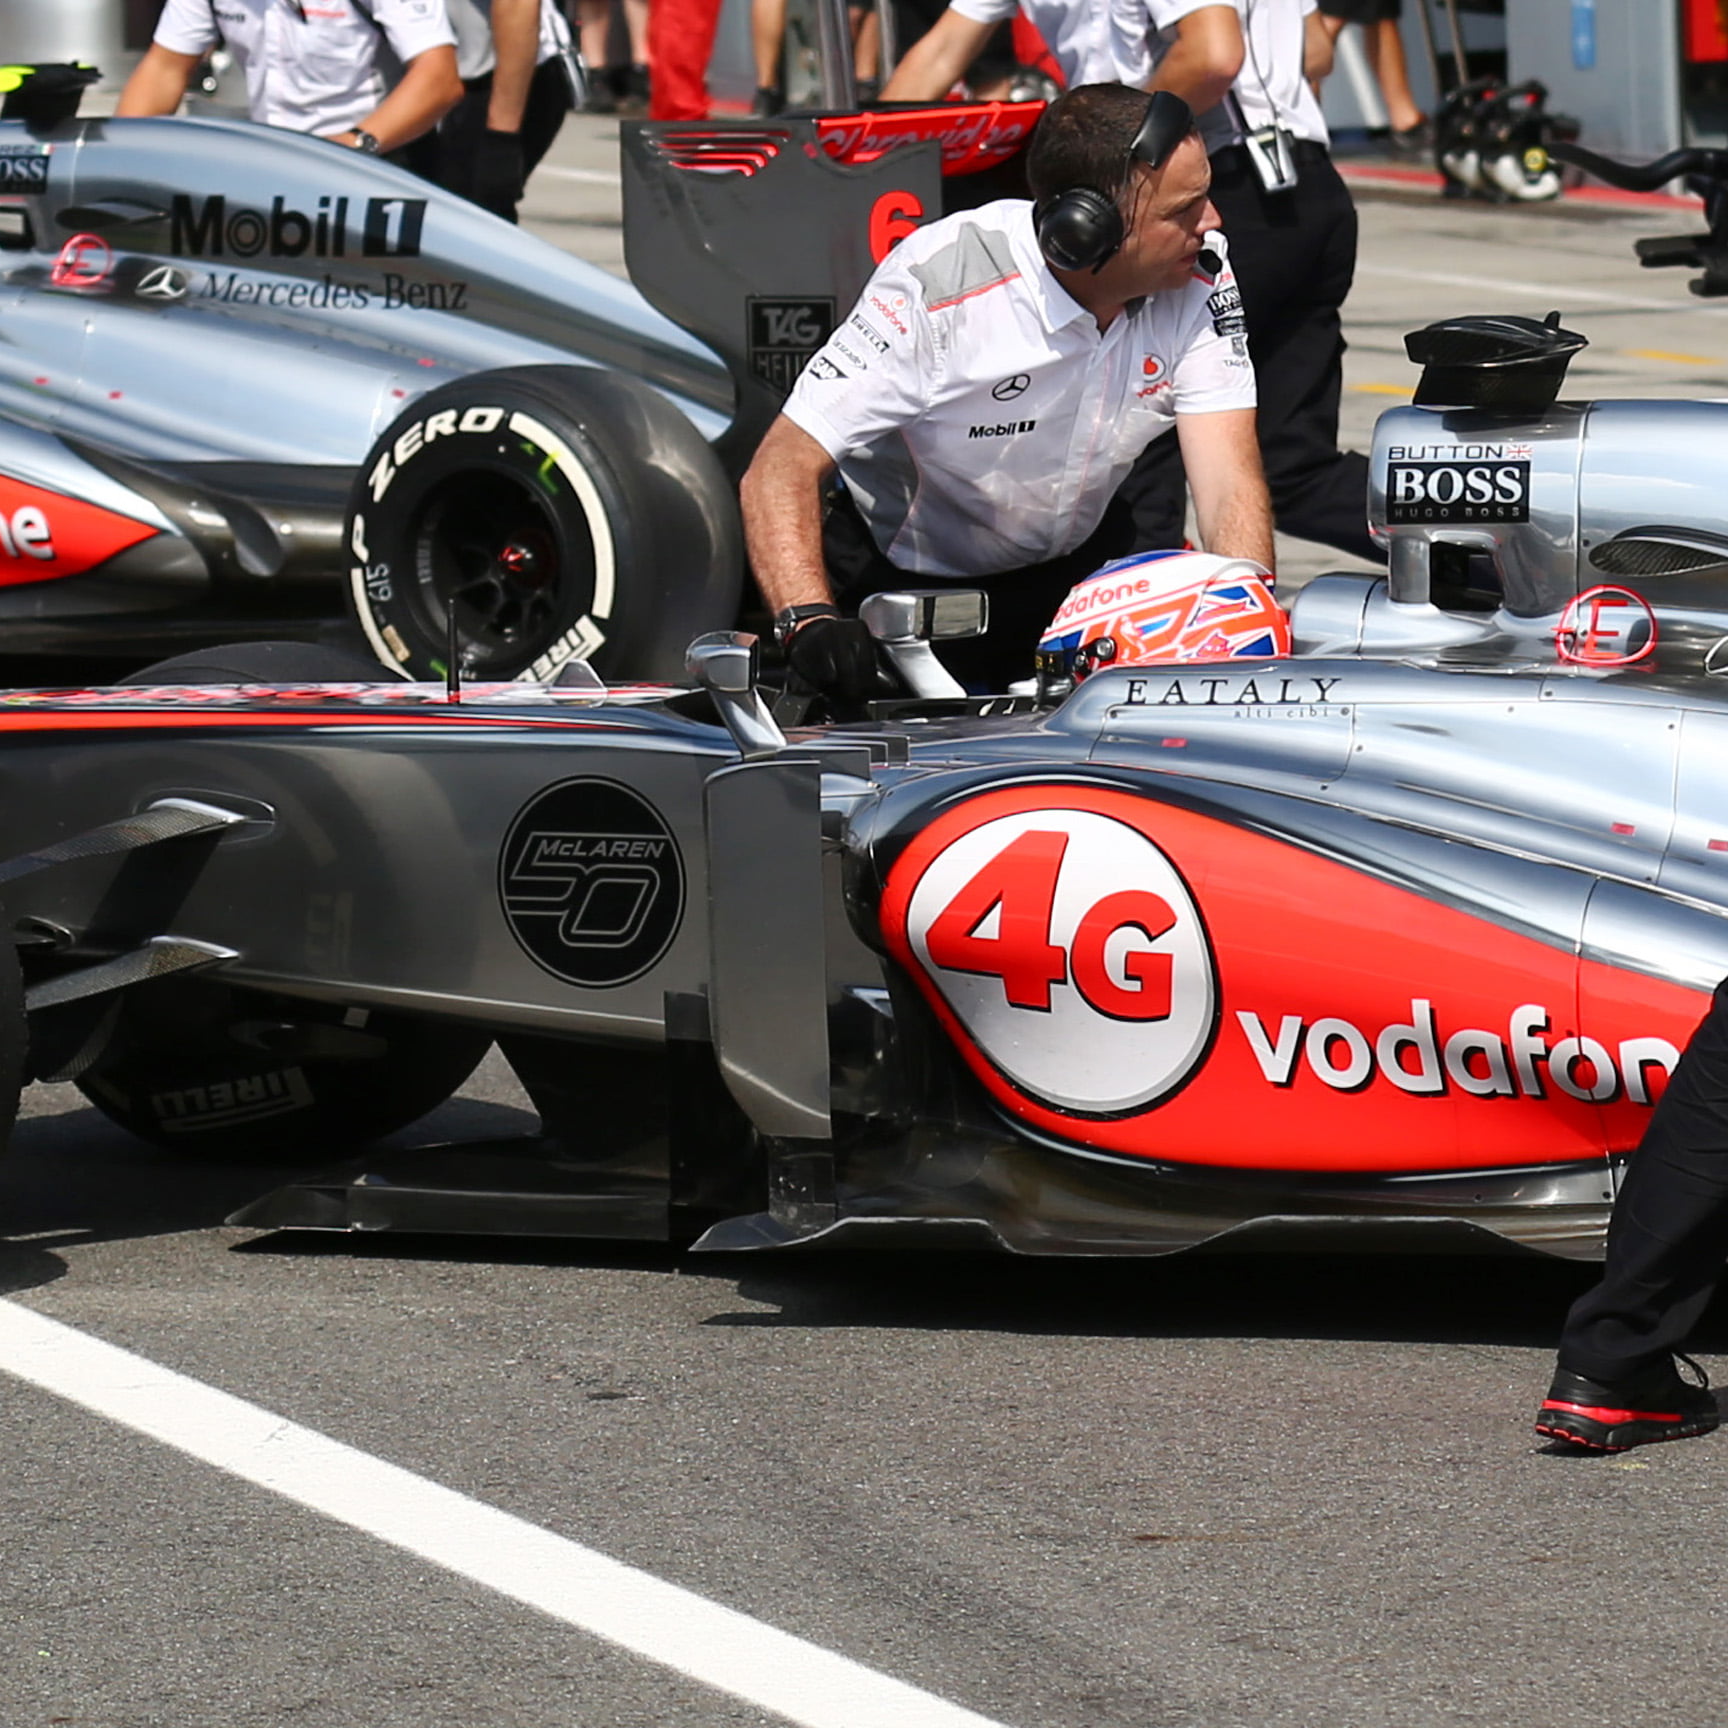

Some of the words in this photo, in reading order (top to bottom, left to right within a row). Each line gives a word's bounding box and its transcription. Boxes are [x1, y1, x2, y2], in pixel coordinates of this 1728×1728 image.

[173, 195, 345, 258] Mobil
[869, 190, 924, 270] 6
[199, 274, 468, 310] Mercedes-Benz
[761, 307, 821, 345] TAG
[850, 313, 891, 354] PIRELLI
[870, 296, 909, 335] vodafone
[969, 422, 1016, 439] Mobil
[370, 407, 504, 503] ZERO
[1389, 445, 1503, 460] BUTTON
[1393, 467, 1522, 504] BOSS
[1394, 507, 1450, 518] HUGO
[1465, 507, 1520, 517] BOSS
[1125, 678, 1342, 705] EATALY
[1234, 706, 1272, 719] alti
[1287, 706, 1329, 719] cibi
[540, 839, 666, 859] McLAREN
[923, 830, 1176, 1023] 4G
[1237, 999, 1682, 1106] vodafon
